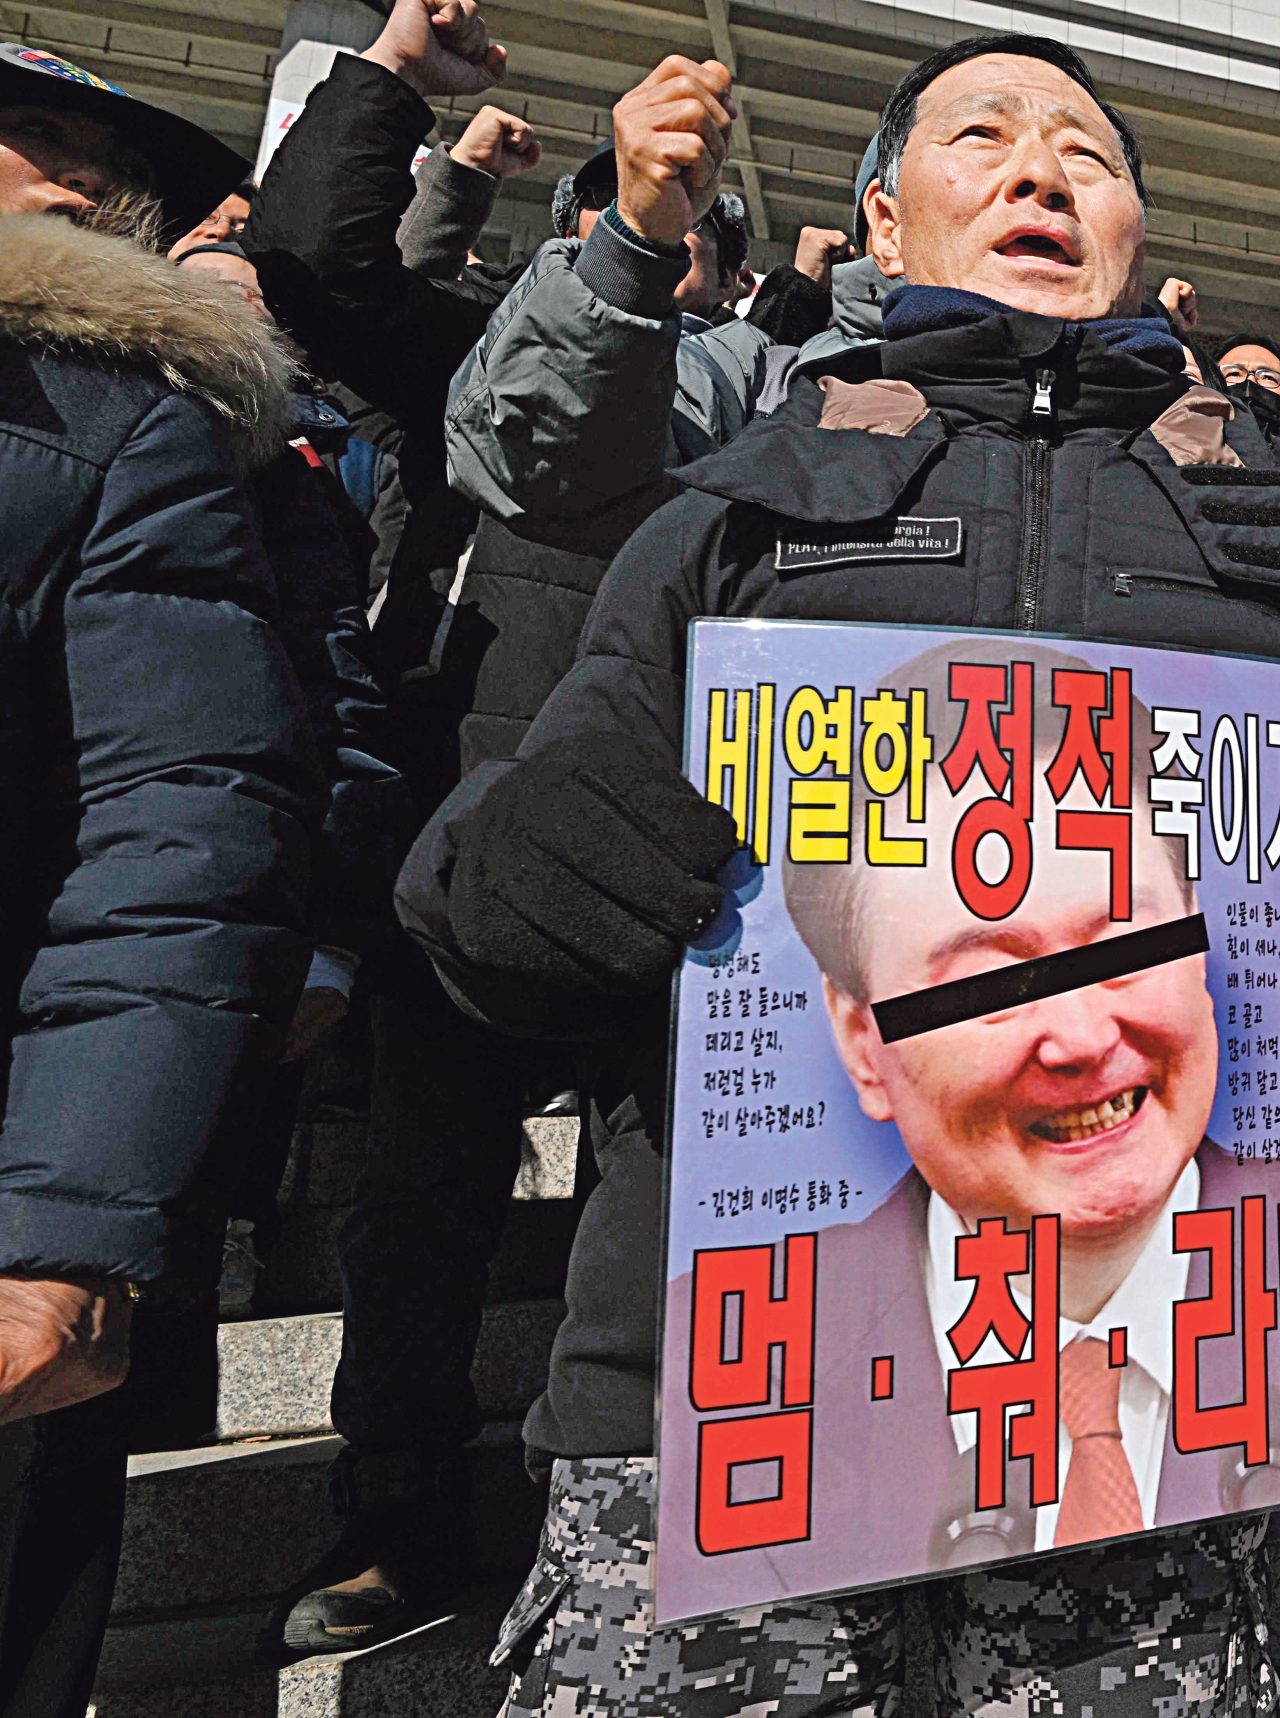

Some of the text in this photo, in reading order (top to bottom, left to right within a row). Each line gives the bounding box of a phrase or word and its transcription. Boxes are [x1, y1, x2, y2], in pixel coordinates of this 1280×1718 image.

[706, 683, 933, 868] 비열한
[940, 660, 1134, 922] 정적
[1226, 901, 1258, 927] 인물이
[1226, 933, 1250, 959] 힘이
[1227, 972, 1239, 989] 배
[707, 986, 808, 1018] 말을 잘 들으니까
[1227, 1002, 1263, 1029] 코 골고
[750, 1027, 783, 1058] 살지,
[1227, 1037, 1251, 1063] 많이
[704, 1066, 777, 1097] 저런걸 누가
[1227, 1070, 1251, 1097] 방귀
[1256, 1069, 1278, 1096] 달고
[701, 1101, 826, 1138] 같이 살아주겠어요?
[1232, 1105, 1256, 1131] 당신
[1232, 1139, 1256, 1166] 같이
[760, 1182, 800, 1215] 이명수
[806, 1180, 832, 1212] 통화
